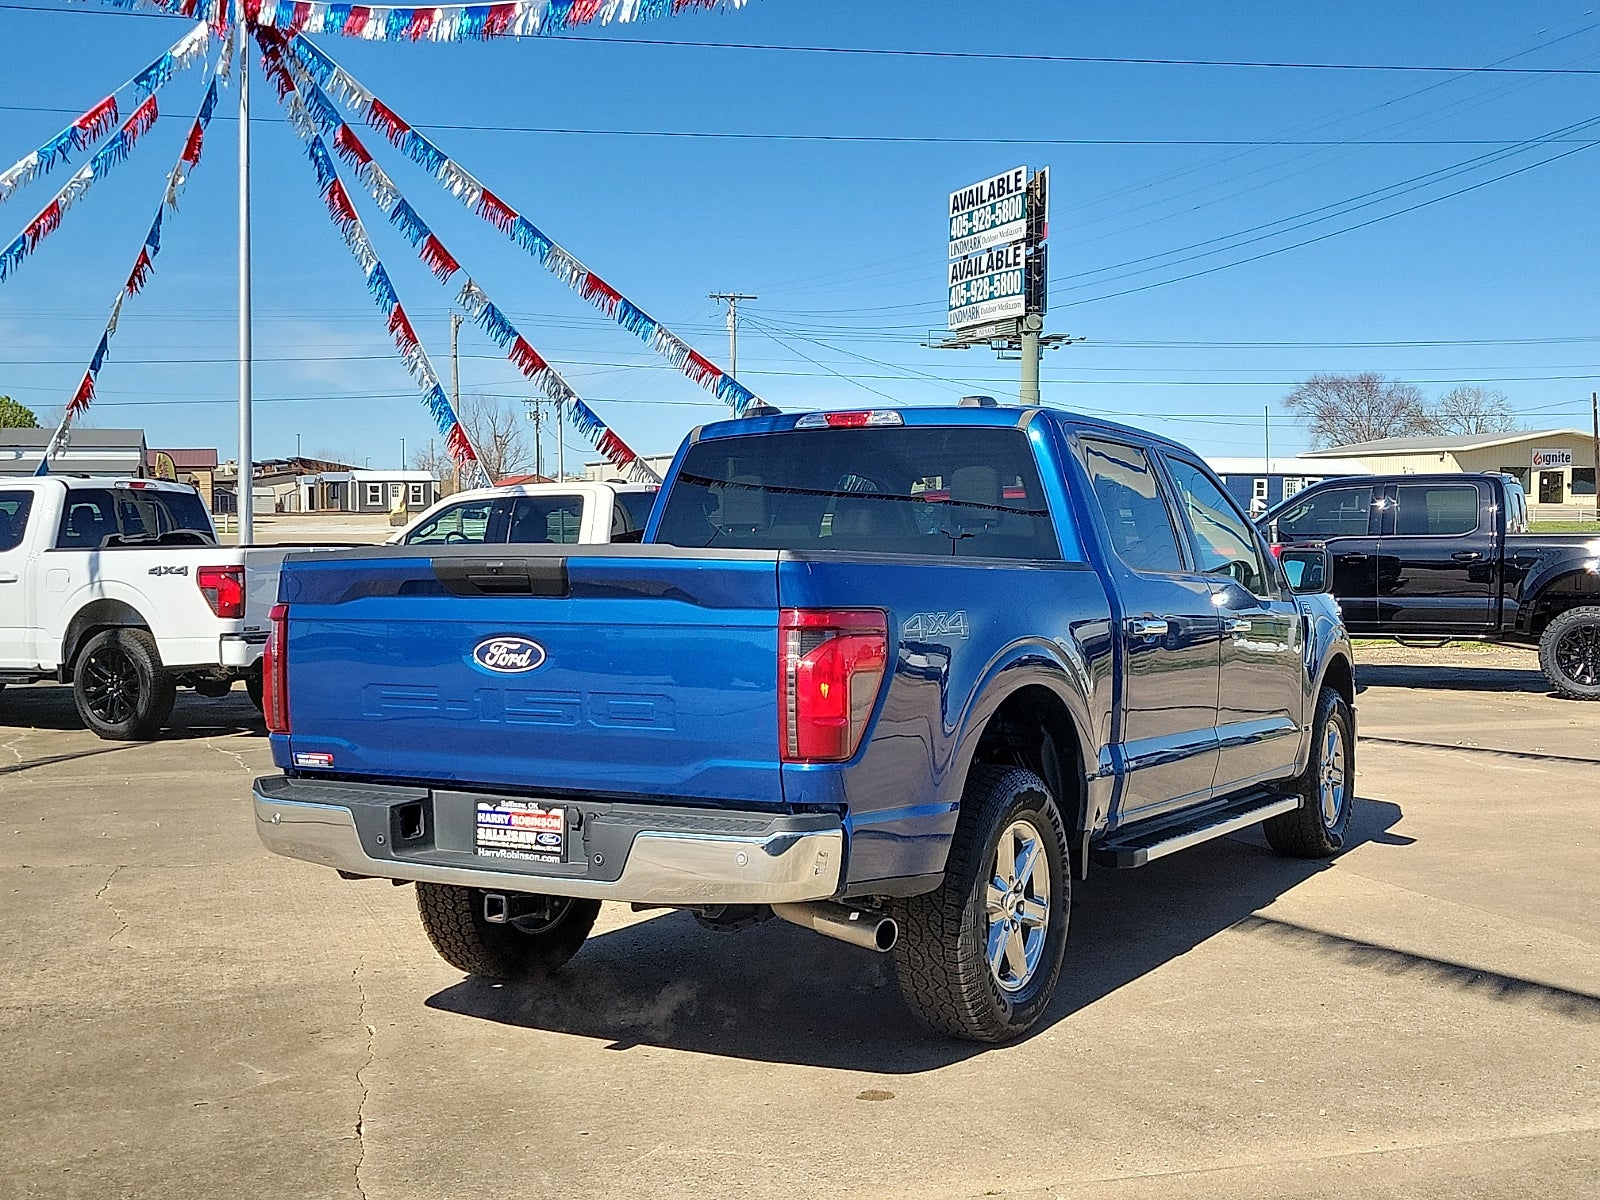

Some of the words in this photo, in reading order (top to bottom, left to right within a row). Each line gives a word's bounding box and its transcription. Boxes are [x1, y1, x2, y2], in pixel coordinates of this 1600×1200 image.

[951, 170, 1022, 214] AVAILABLE
[951, 195, 1023, 240] 405-928-5800
[950, 236, 982, 256] LINDMARK
[951, 246, 1021, 284] AVAILABLE
[949, 270, 1021, 308] 405-928-5800
[949, 305, 980, 326] LINDMARK
[1542, 450, 1571, 465] ignite
[485, 642, 532, 667] Ford
[363, 683, 676, 731] F-150
[528, 802, 539, 810] OK
[477, 812, 511, 825] HARRY
[511, 815, 560, 829] ROBINSON
[477, 828, 537, 844] SALLISAW
[477, 847, 560, 864] HarryRobinson.com
[1046, 804, 1069, 914] WRANGLER
